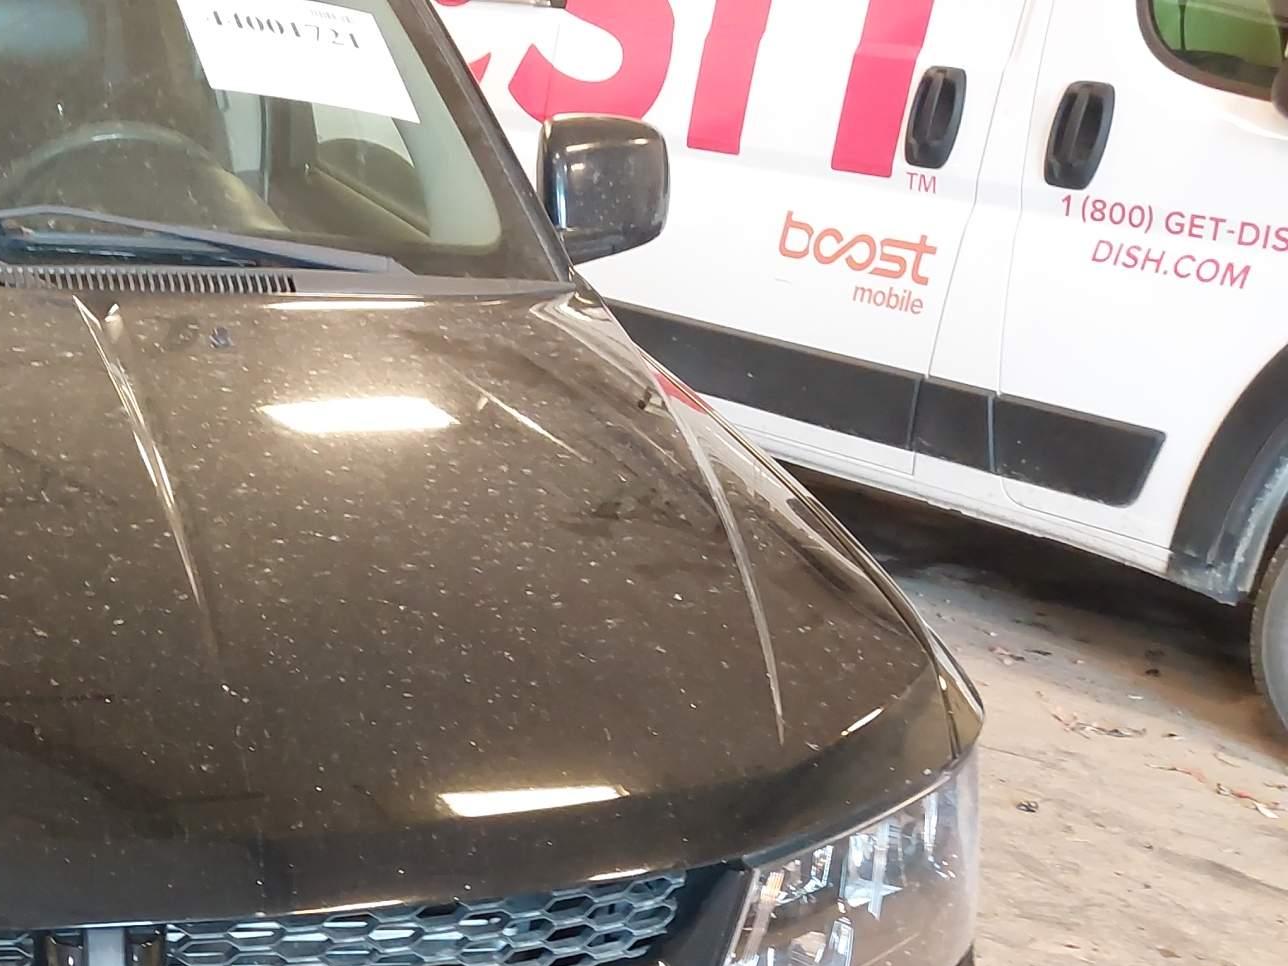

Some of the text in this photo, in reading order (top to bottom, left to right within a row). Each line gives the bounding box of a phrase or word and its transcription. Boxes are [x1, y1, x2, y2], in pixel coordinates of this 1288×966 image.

[906, 171, 937, 194] TM
[1062, 194, 1072, 217] 1
[1081, 195, 1153, 234] (800)
[778, 210, 937, 286] boost
[1091, 239, 1251, 289] DISH.COM
[852, 285, 924, 315] mobile
